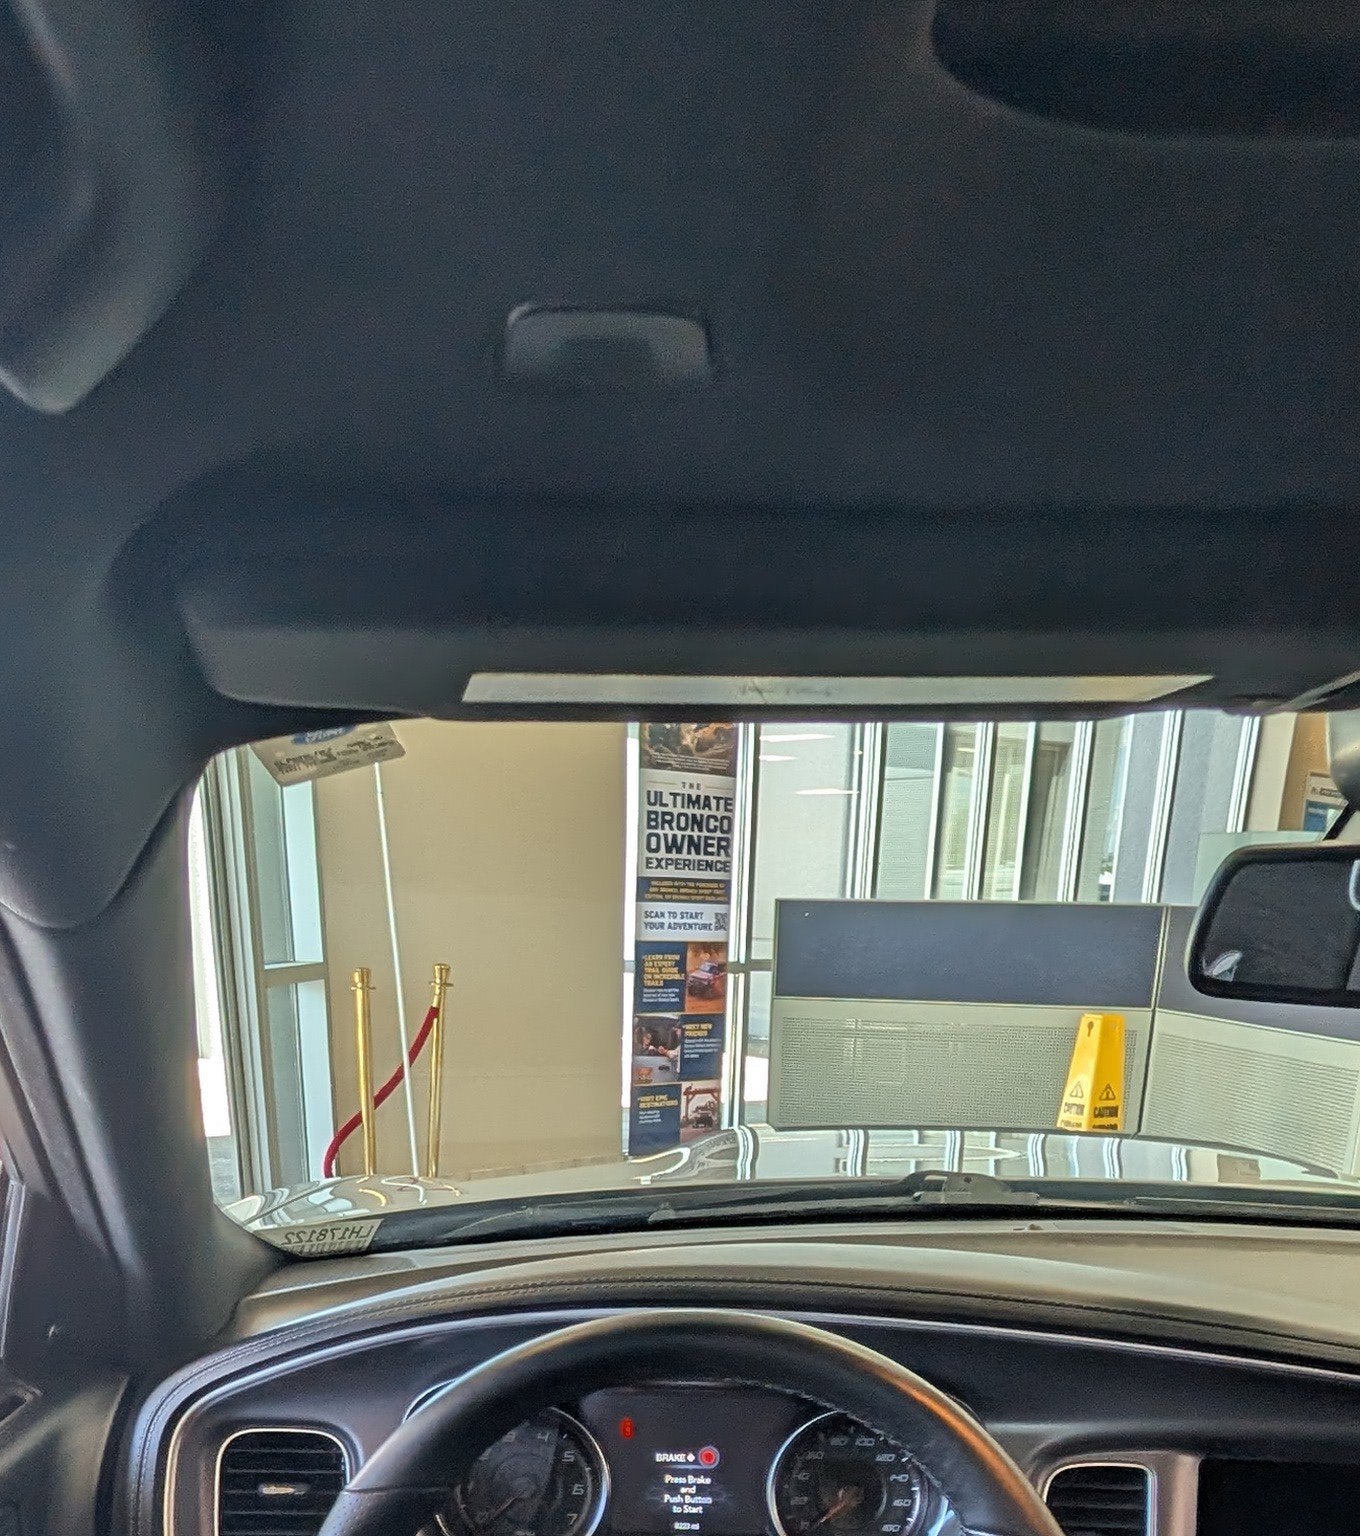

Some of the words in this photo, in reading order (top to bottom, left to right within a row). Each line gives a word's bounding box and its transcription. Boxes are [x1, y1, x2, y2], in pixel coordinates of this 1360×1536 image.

[681, 781, 702, 791] THE
[646, 790, 734, 813] ULTIMATE
[646, 811, 732, 834] BRONCO
[645, 833, 731, 857] OWNER
[645, 857, 731, 873] EXPERIENCE
[644, 911, 665, 919] SCAN
[667, 911, 677, 919] TO
[680, 911, 704, 920] START
[644, 922, 666, 931] YOUR
[667, 922, 713, 931] ADVENTURE
[562, 1451, 576, 1462] 5
[655, 1453, 686, 1462] BRAKE
[664, 1474, 686, 1484] Press
[688, 1475, 711, 1484] Brake
[572, 1484, 585, 1495] 6
[680, 1485, 696, 1494] and
[664, 1494, 683, 1503] Push
[685, 1495, 712, 1504] Button
[672, 1504, 682, 1513] to
[683, 1504, 703, 1514] Start
[567, 1513, 577, 1524] 7
